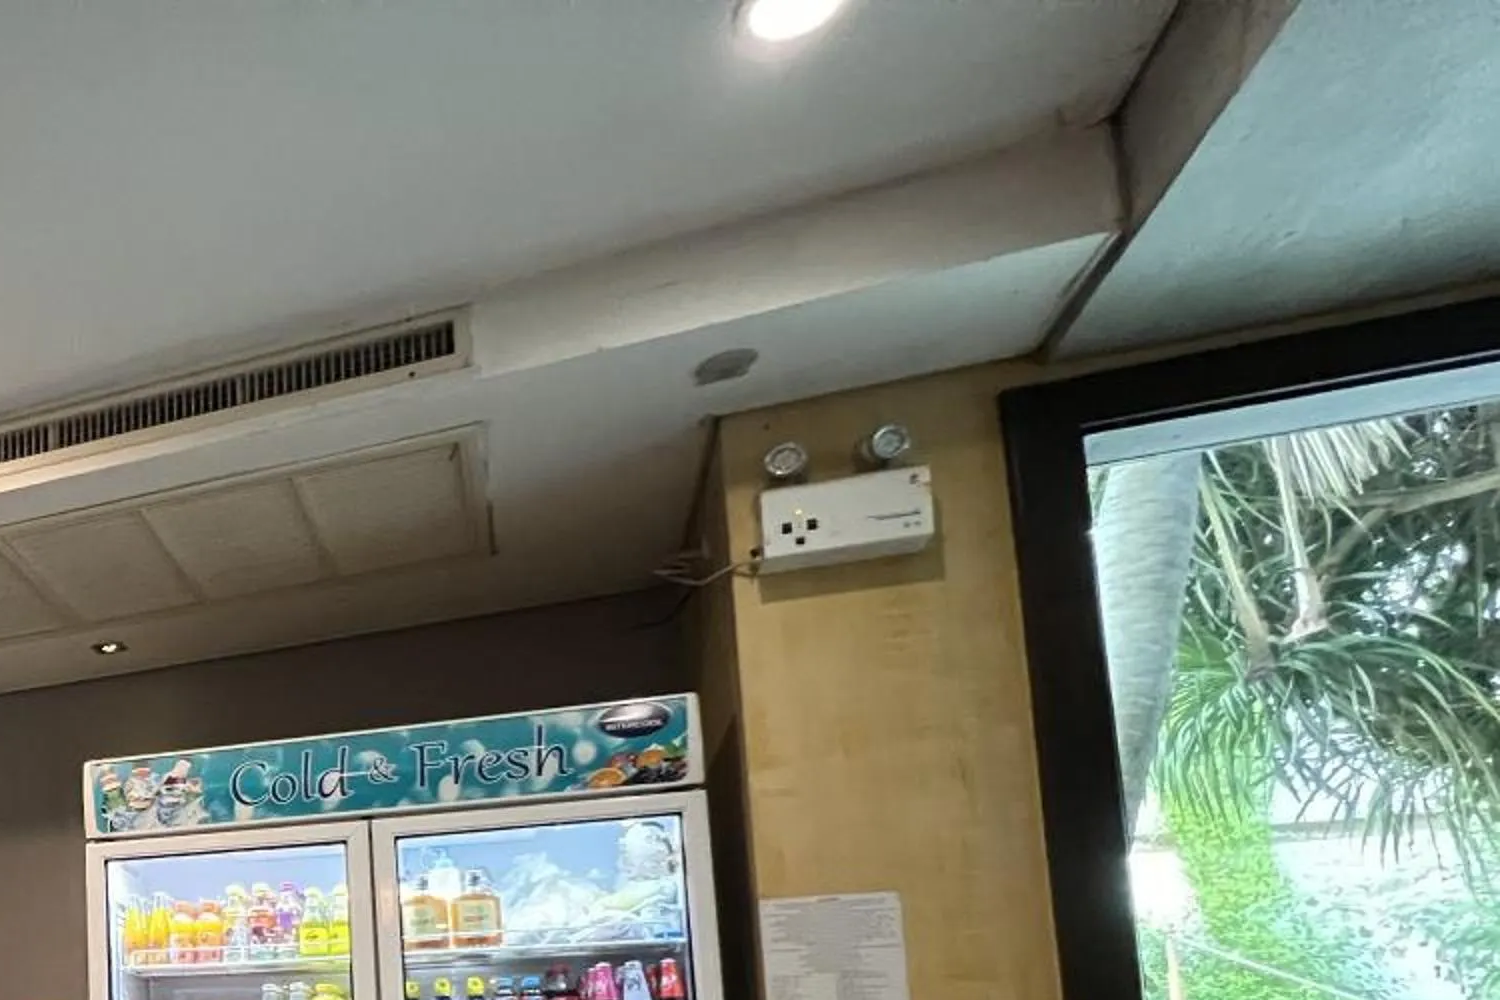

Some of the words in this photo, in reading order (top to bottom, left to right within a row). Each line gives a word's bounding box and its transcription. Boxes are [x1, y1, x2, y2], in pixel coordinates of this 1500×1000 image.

[230, 745, 354, 807] Cold
[368, 755, 398, 784] &
[408, 722, 574, 789] Fresh
